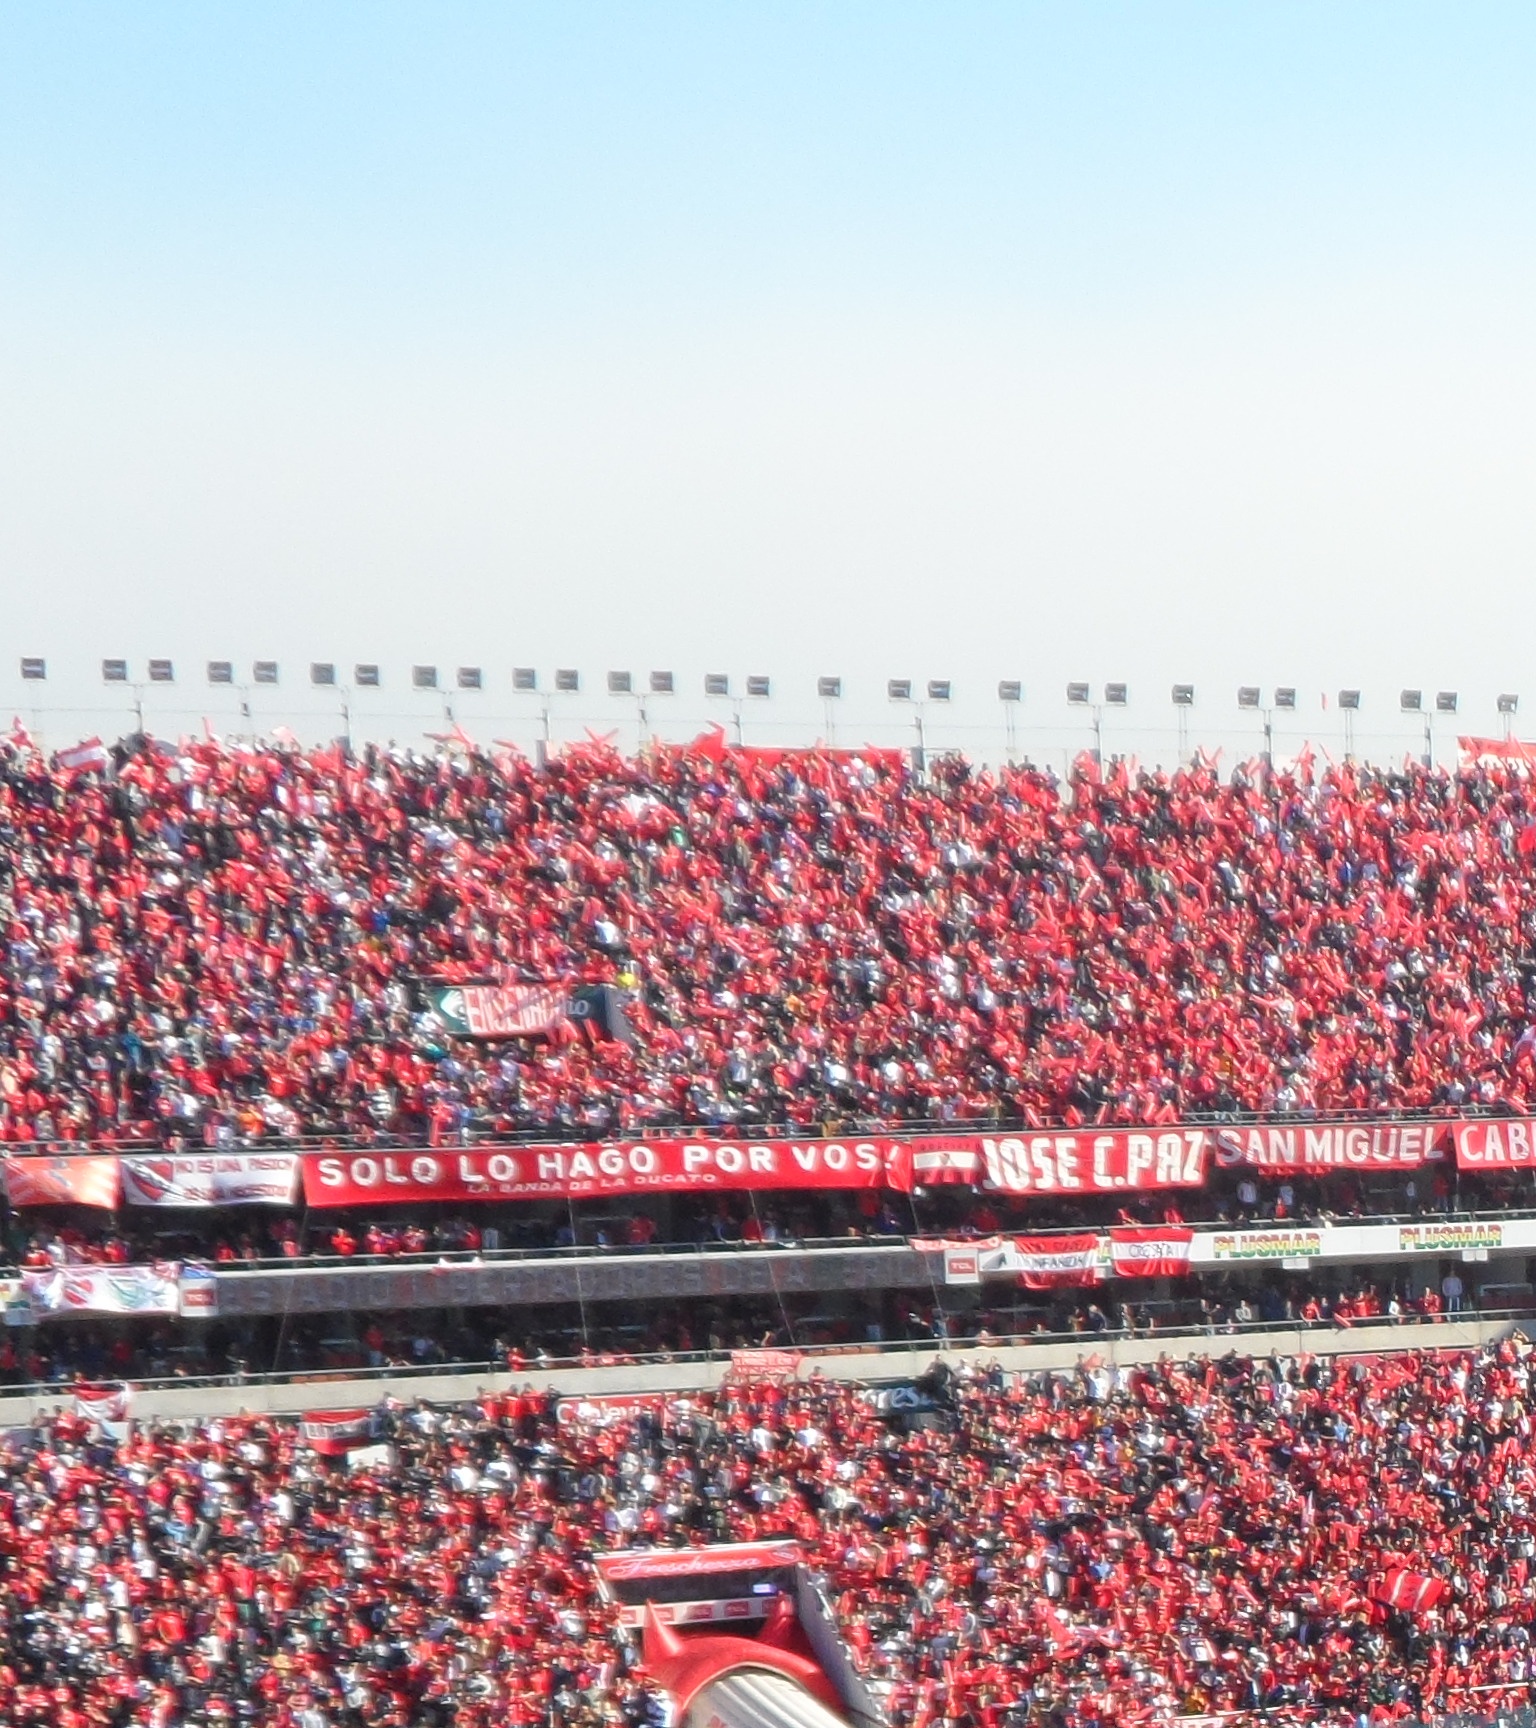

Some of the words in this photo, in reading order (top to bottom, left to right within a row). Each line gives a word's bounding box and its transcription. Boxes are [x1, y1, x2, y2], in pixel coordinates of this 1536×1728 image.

[1216, 1129, 1295, 1165] SAN
[1304, 1126, 1444, 1164] MIGUEL
[318, 1155, 440, 1187] SOLO
[458, 1154, 519, 1183] LO
[536, 1146, 655, 1181] HAGO
[682, 1145, 776, 1174] POR
[791, 1143, 899, 1173] VOS!
[982, 1136, 1081, 1191] JOSE
[467, 1182, 491, 1194] LA
[500, 1180, 562, 1194] BANDA
[569, 1179, 592, 1192] DE
[600, 1177, 626, 1189] LA
[634, 1173, 717, 1186] DUCATO
[1213, 1231, 1322, 1259] PLUSMAR
[1399, 1223, 1503, 1251] PLUSMAR
[951, 1262, 974, 1272] TCL
